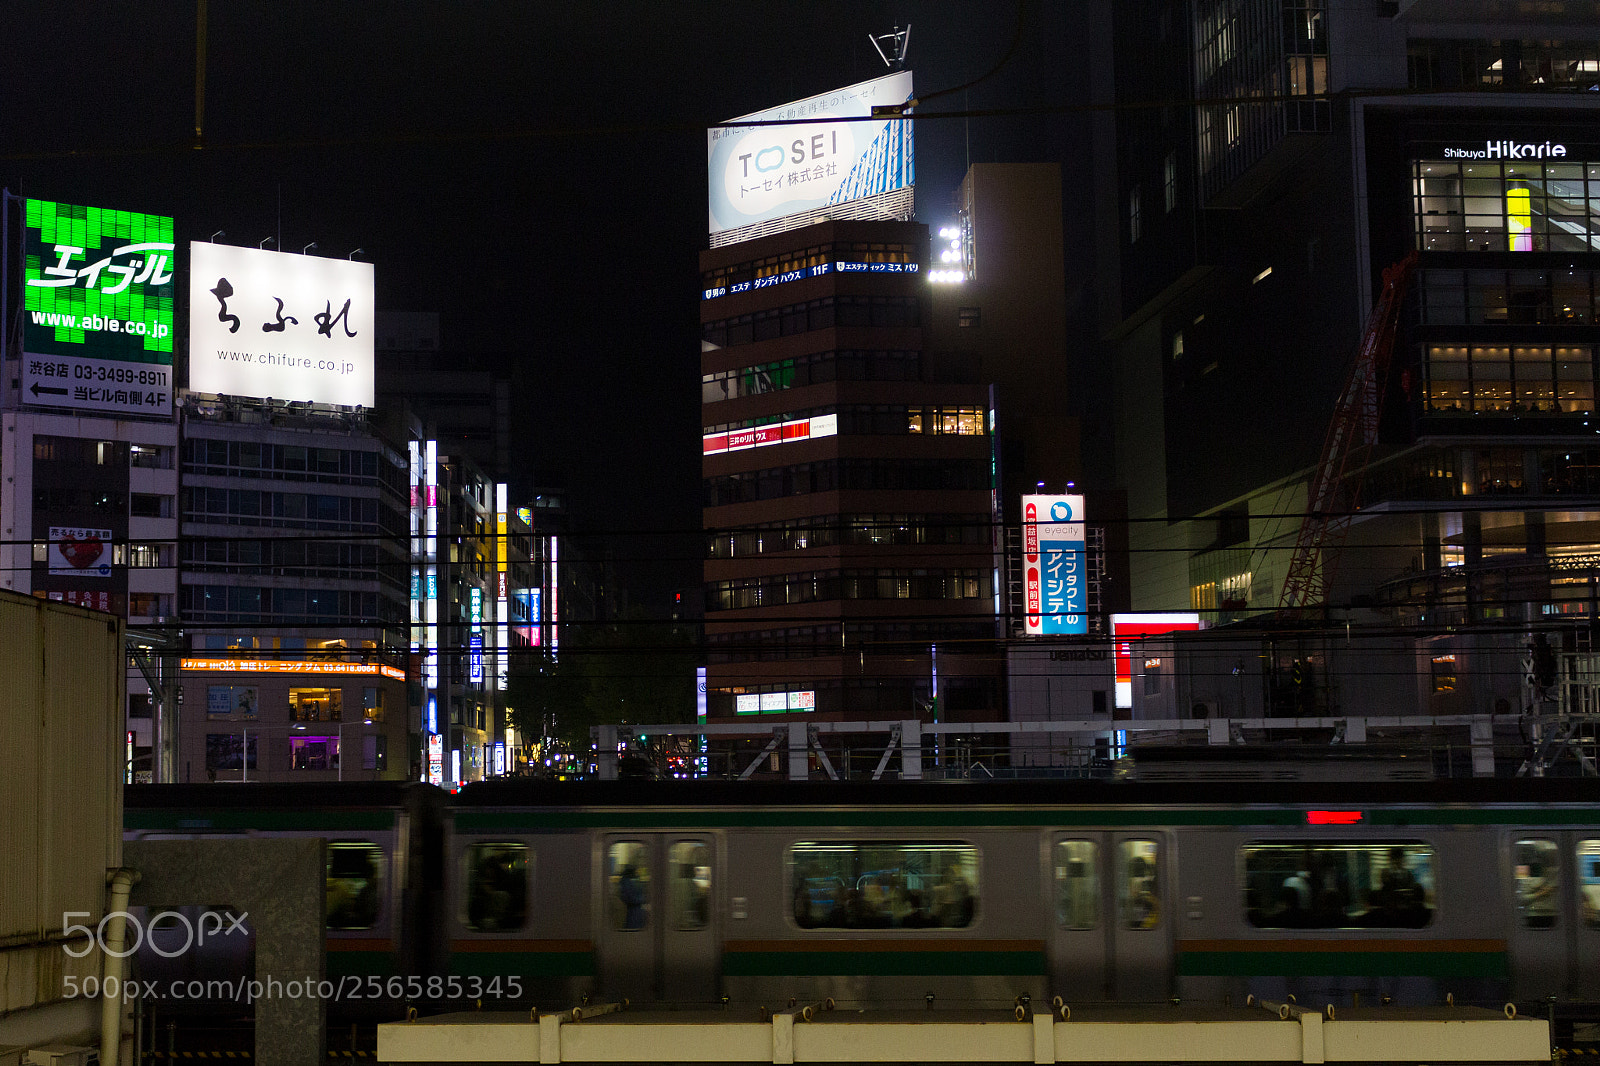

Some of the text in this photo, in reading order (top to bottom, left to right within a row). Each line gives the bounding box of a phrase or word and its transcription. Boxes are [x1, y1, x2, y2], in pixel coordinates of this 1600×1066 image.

[1444, 140, 1567, 160] Shibuya Hikarie
[740, 161, 838, 199] トーセイ株式会社
[27, 242, 176, 295] エイブル
[811, 264, 829, 276] 11F
[209, 277, 358, 339] ちふれ
[31, 310, 169, 339] www.able.co.jp
[29, 359, 167, 387] 渋谷店 03-3499-8911
[216, 348, 355, 375] www.chifure.co.jp
[144, 392, 167, 408] 4F
[729, 431, 767, 446] 三井のリハウス
[1044, 526, 1079, 537] eyecity
[1028, 580, 1038, 609] 駅前店
[1046, 549, 1064, 625] アイシティ
[1065, 549, 1079, 625] コンタクトの
